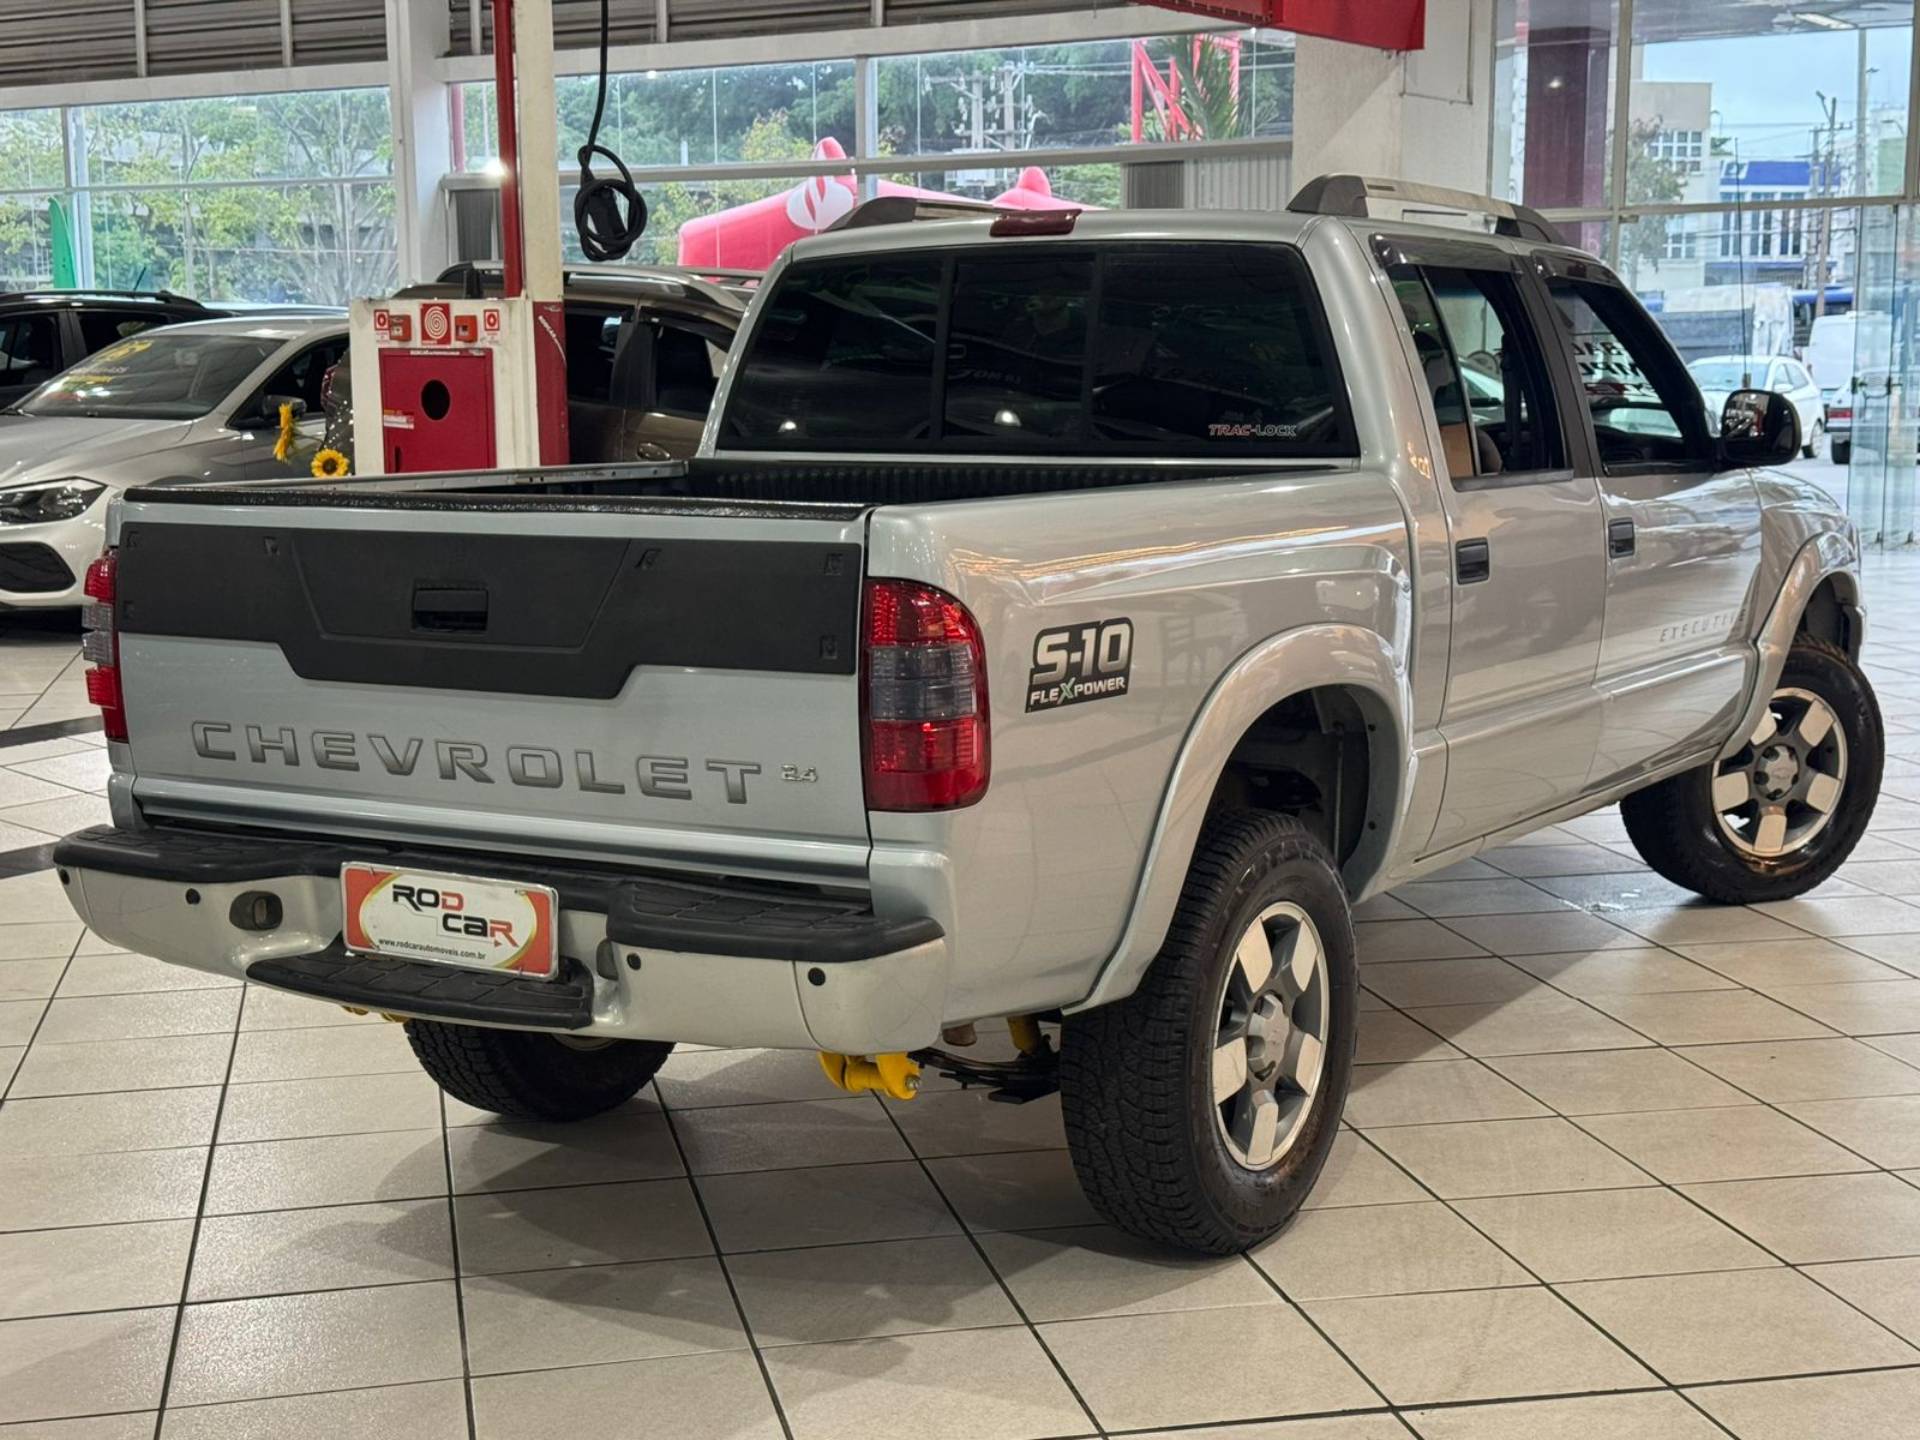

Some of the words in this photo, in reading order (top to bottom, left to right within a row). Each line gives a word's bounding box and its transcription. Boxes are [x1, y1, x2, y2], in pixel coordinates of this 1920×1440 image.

[1208, 423, 1297, 437] TRAC-LOCK
[1032, 623, 1130, 685] S-10
[1030, 676, 1126, 706] FLEXPOWER
[191, 719, 761, 804] CHEVROLET
[780, 763, 818, 783] 2.4
[392, 883, 465, 912] ROD
[378, 937, 487, 961] www.rodcarautomoveis.com.br
